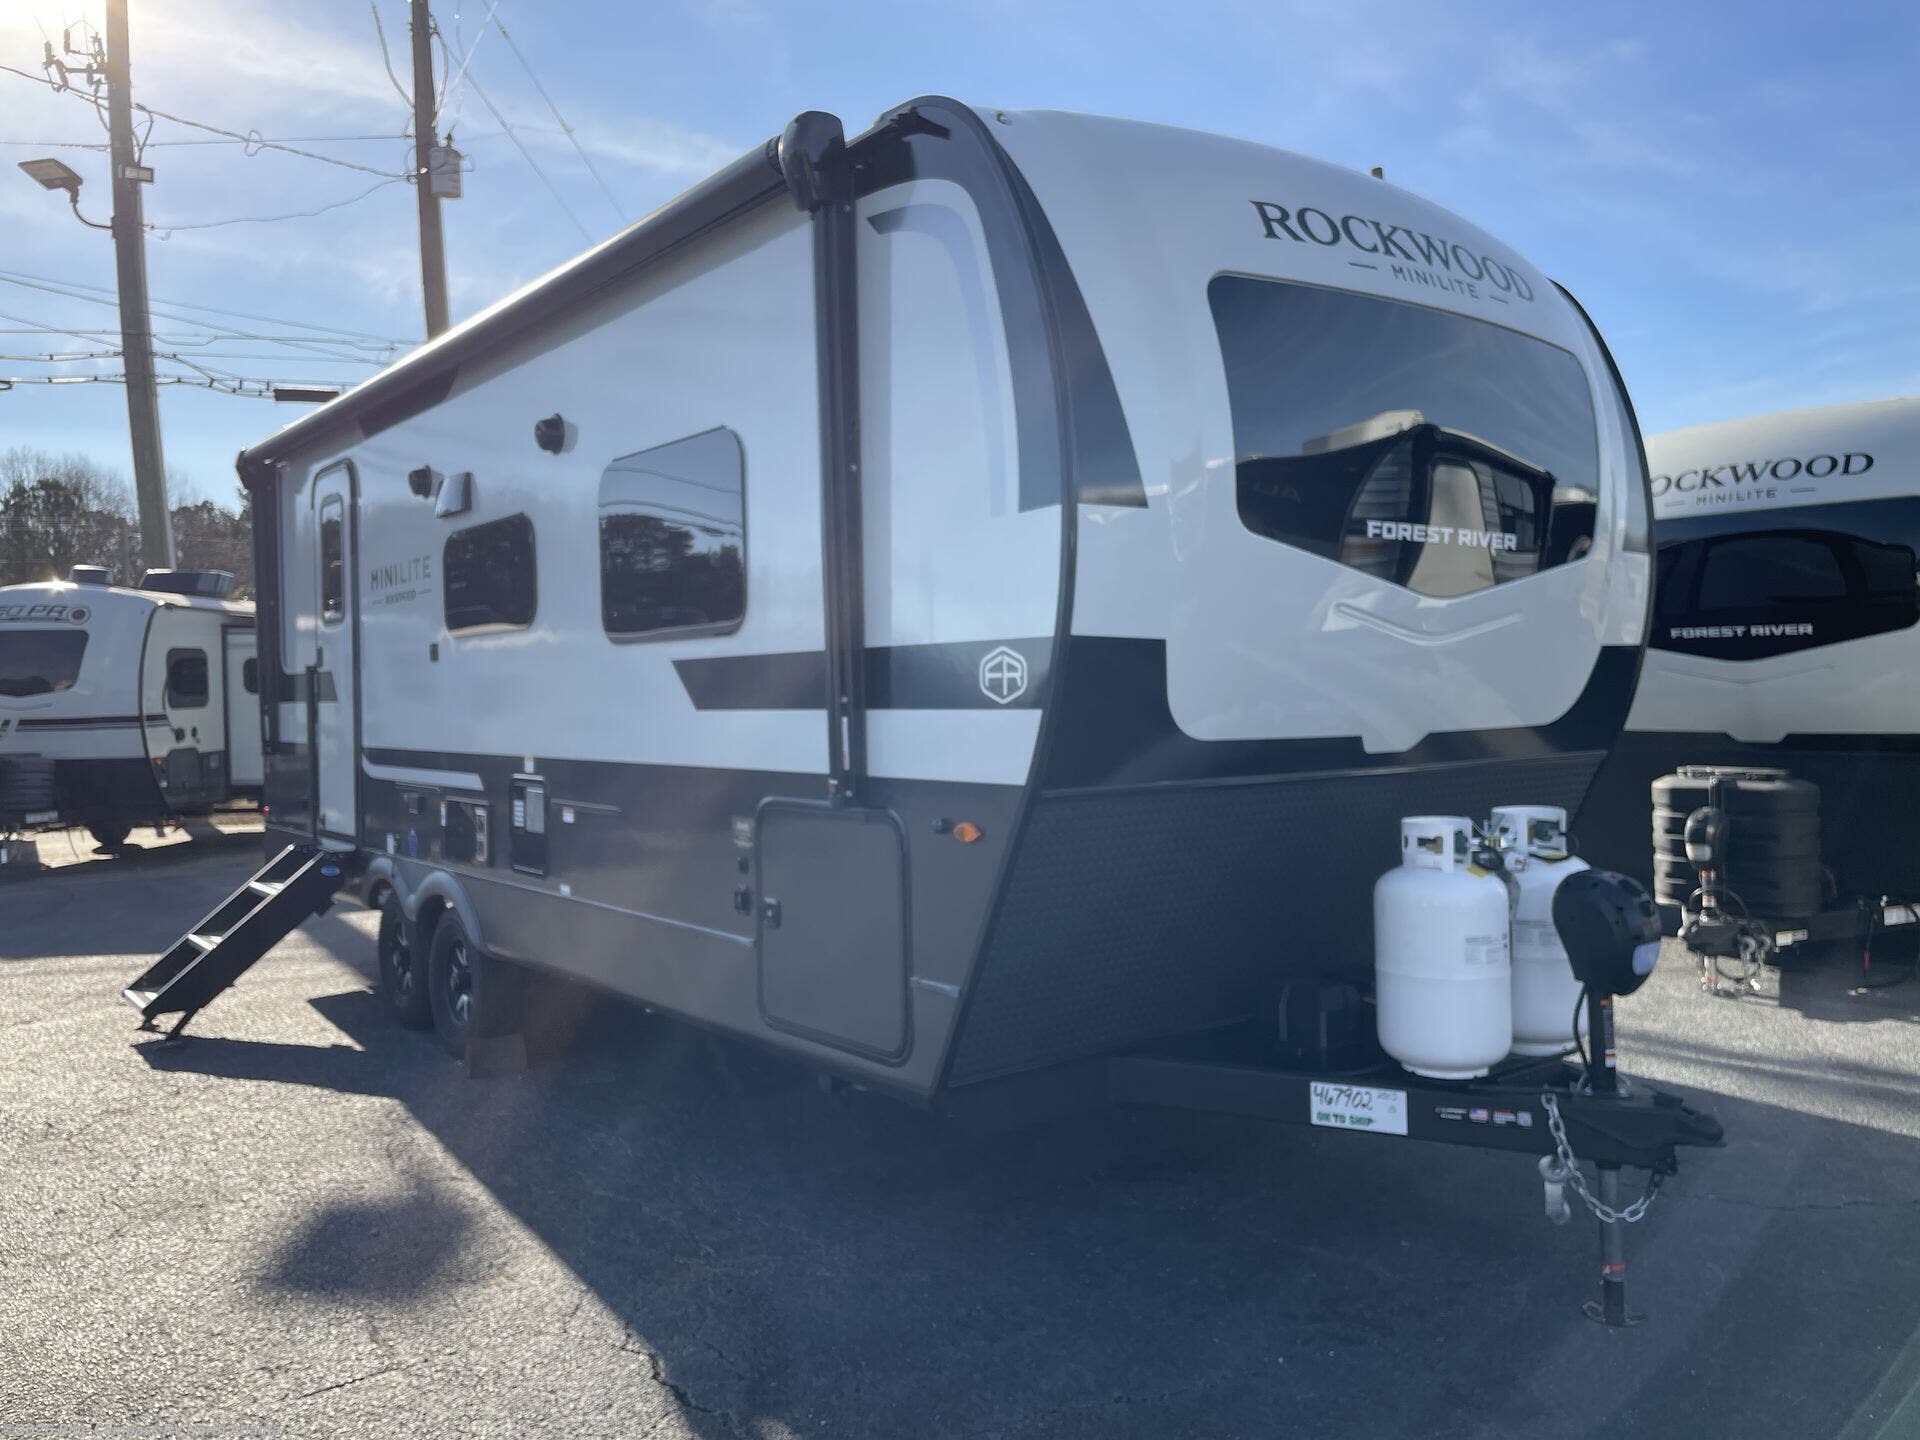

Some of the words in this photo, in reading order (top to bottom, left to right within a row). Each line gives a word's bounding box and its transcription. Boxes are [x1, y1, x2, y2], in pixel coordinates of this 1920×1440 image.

[1249, 200, 1534, 302] ROCKWOOD
[1391, 264, 1480, 299] MINILITE
[1650, 452, 1874, 497] OCKWOOD
[1695, 487, 1778, 506] MINILITE
[1366, 520, 1454, 545] FOREST
[1458, 527, 1517, 551] RIVER
[370, 555, 432, 592] MINILITE
[1670, 625, 1747, 639] FOREST
[1750, 623, 1813, 637] RIVER
[1313, 1085, 1373, 1111] 467902
